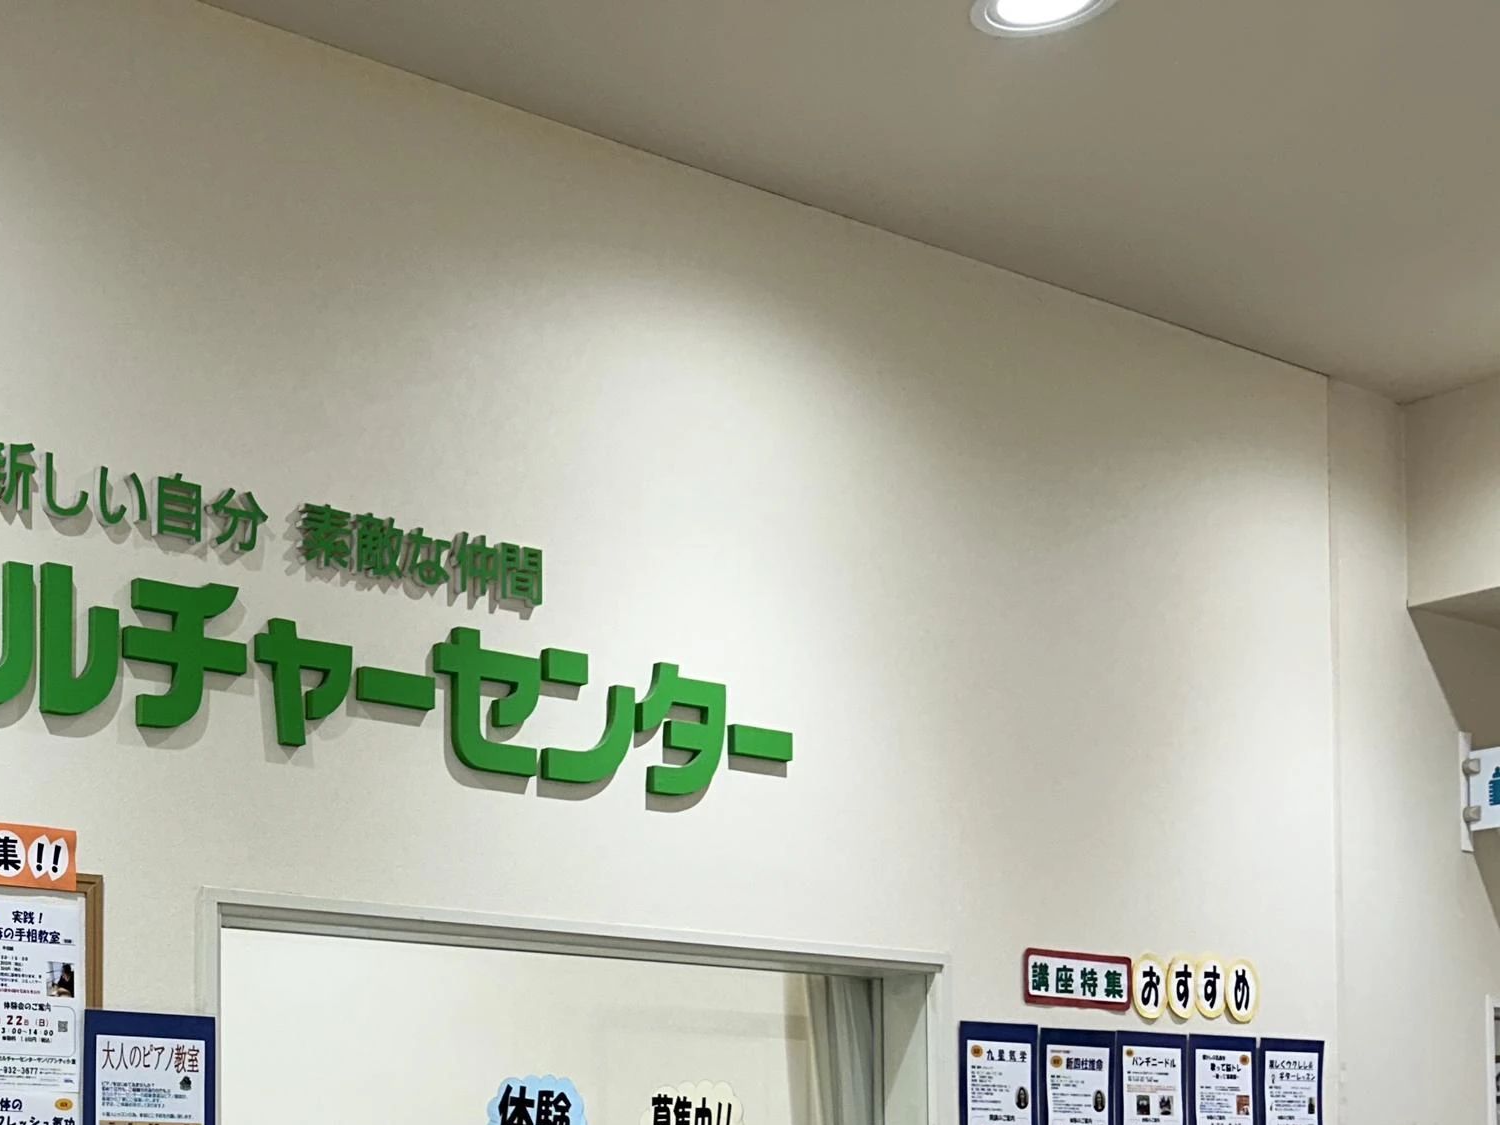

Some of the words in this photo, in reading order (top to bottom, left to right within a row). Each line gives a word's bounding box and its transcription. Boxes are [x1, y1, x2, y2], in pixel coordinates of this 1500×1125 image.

[300, 503, 544, 606] 素敵な仲間
[12, 910, 44, 924] 実践！
[1031, 961, 1124, 1000] 講座特集
[1141, 964, 1250, 1011] おすすめ
[101, 1040, 200, 1073] 大人のピアノ教室
